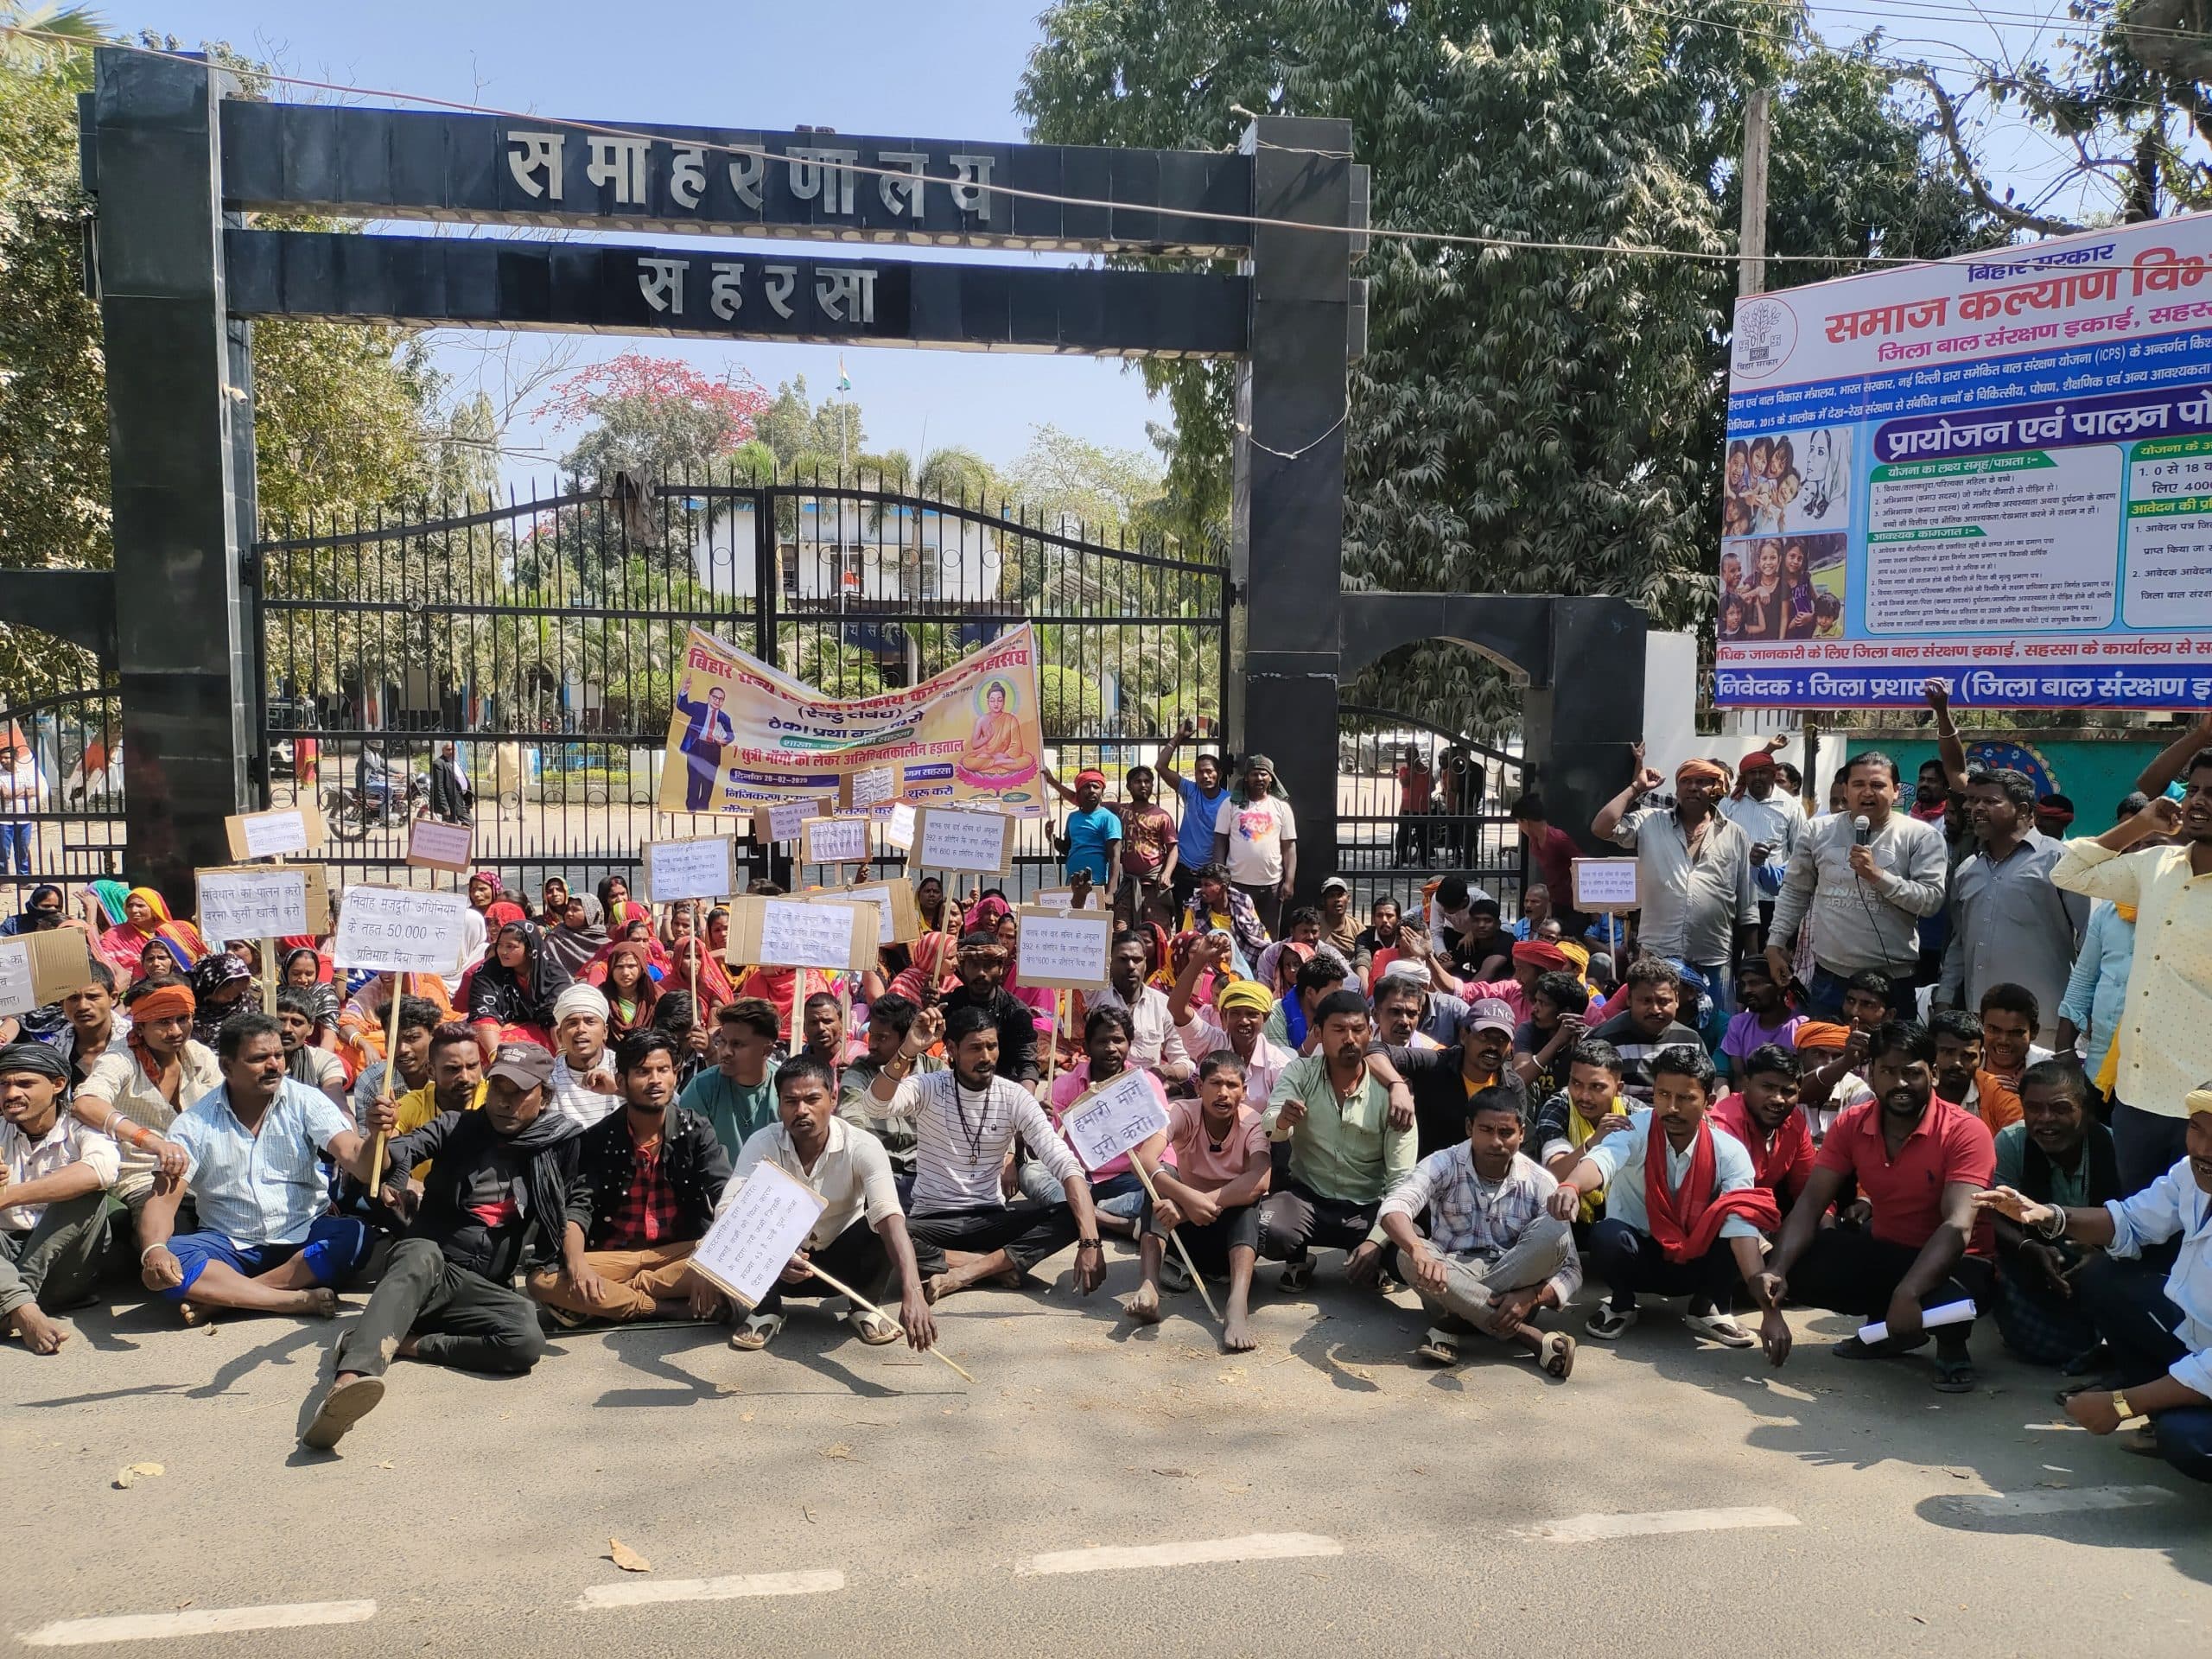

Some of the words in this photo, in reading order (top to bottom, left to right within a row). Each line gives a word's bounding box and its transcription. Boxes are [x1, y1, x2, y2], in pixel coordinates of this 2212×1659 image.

[507, 130, 995, 221] समाहरणालय
[1967, 258, 2030, 283] बिहार
[2031, 243, 2116, 271] सरकार
[638, 257, 878, 323] सहरसा
[1825, 296, 1950, 343] समाज
[1958, 268, 2122, 321] कल्याण
[1878, 340, 1933, 362] जिला
[1936, 334, 1980, 353] बाल
[1984, 323, 2060, 346] संरक्षण
[2063, 306, 2139, 337] इकाई,
[1745, 395, 1758, 408] एवं
[1758, 394, 1774, 406] बाल
[1776, 387, 1802, 404] विकास
[1840, 383, 1860, 396] भारत
[1864, 378, 1895, 393] सरकार,
[1898, 373, 1913, 389] नई
[1915, 369, 1940, 385] दिल्ली
[1942, 370, 1960, 383] द्वारा
[1963, 361, 1999, 379] समेकित
[2002, 361, 2021, 374] बाल
[2024, 354, 2056, 372] संरक्षण
[2058, 349, 2091, 366] योजना
[2094, 344, 2125, 365] (ICPS)
[2129, 343, 2141, 358] के
[2143, 335, 2186, 356] अन्तर्गत
[1760, 416, 1775, 427] 2015
[1777, 412, 1785, 425] के
[1787, 409, 1815, 424] आलोक
[1817, 407, 1827, 420] में
[1866, 399, 1892, 415] संरक्षण
[1895, 397, 1904, 410] से
[1940, 390, 1962, 405] बच्चों
[1963, 389, 1974, 403] के
[1976, 381, 2026, 402] चिकित्सीय,
[2030, 378, 2058, 396] पोषण,
[2063, 372, 2103, 391] शैक्षणिक
[2107, 370, 2123, 386] एवं
[2123, 370, 2147, 384] अन्य
[2151, 362, 2211, 380] आवश्यकता
[1888, 418, 2014, 460] प्रायोजन
[2018, 405, 2065, 443] एवं
[2071, 403, 2171, 436] पालन
[2140, 442, 2181, 455] योजना
[2185, 441, 2197, 451] के
[1888, 464, 1920, 477] योजना
[1921, 464, 1936, 474] का
[1938, 462, 1961, 473] लक्ष्य
[2139, 467, 2148, 477] 1.
[2154, 466, 2161, 475] 0
[2166, 461, 2178, 474] से
[2184, 463, 2199, 473] 18
[1988, 474, 1995, 483] के
[2152, 480, 2177, 494] लिए
[2017, 485, 2023, 493] से
[2087, 492, 2094, 501] के
[2131, 499, 2175, 514] आवेदन
[2178, 497, 2196, 511] की
[1872, 531, 1915, 541] आवश्यक
[1917, 527, 1962, 537] कागजात
[2145, 521, 2177, 532] आवेदन
[2143, 546, 2163, 555] प्राप्त
[2167, 543, 2189, 554] किया
[2145, 566, 2177, 577] आवेदक
[2140, 589, 2164, 600] जिला
[1749, 645, 1804, 661] जानकारी
[1807, 644, 1821, 659] के
[1824, 644, 1849, 659] लिए
[1853, 643, 1888, 658] जिला
[1891, 645, 1920, 658] बाल
[1922, 641, 1968, 658] संरक्षण
[1972, 640, 2019, 658] इकाई,
[2082, 639, 2097, 655] के
[2102, 637, 2171, 655] कार्यालय
[2176, 637, 2191, 653] से
[687, 647, 733, 679] बिहार
[1717, 672, 1792, 696] निवेदक
[1808, 671, 1866, 696] जिला
[1961, 670, 2038, 702] (जिला
[2041, 677, 2095, 696] बाल
[2097, 670, 2186, 696] संरक्षण
[767, 716, 808, 734] ठेका
[812, 728, 847, 741] प्रथा
[795, 751, 810, 766] को
[813, 753, 840, 766] लेकर
[930, 740, 965, 759] हड़ताल
[932, 785, 953, 796] करो
[240, 888, 251, 899] का
[256, 887, 280, 898] पालन
[284, 883, 302, 897] करो
[257, 905, 278, 918] खाली
[283, 903, 300, 916] करो
[349, 892, 376, 910] निर्वाह
[416, 899, 457, 916] अधिनियम
[347, 918, 357, 934] के
[361, 923, 383, 936] तहत
[357, 946, 390, 963] प्रतिमाह
[394, 949, 412, 964] दिया
[416, 955, 435, 968] जाए
[1484, 1005, 1511, 1020] KING
[1538, 1075, 1555, 1090] 23
[1073, 1100, 1112, 1133] हमारी
